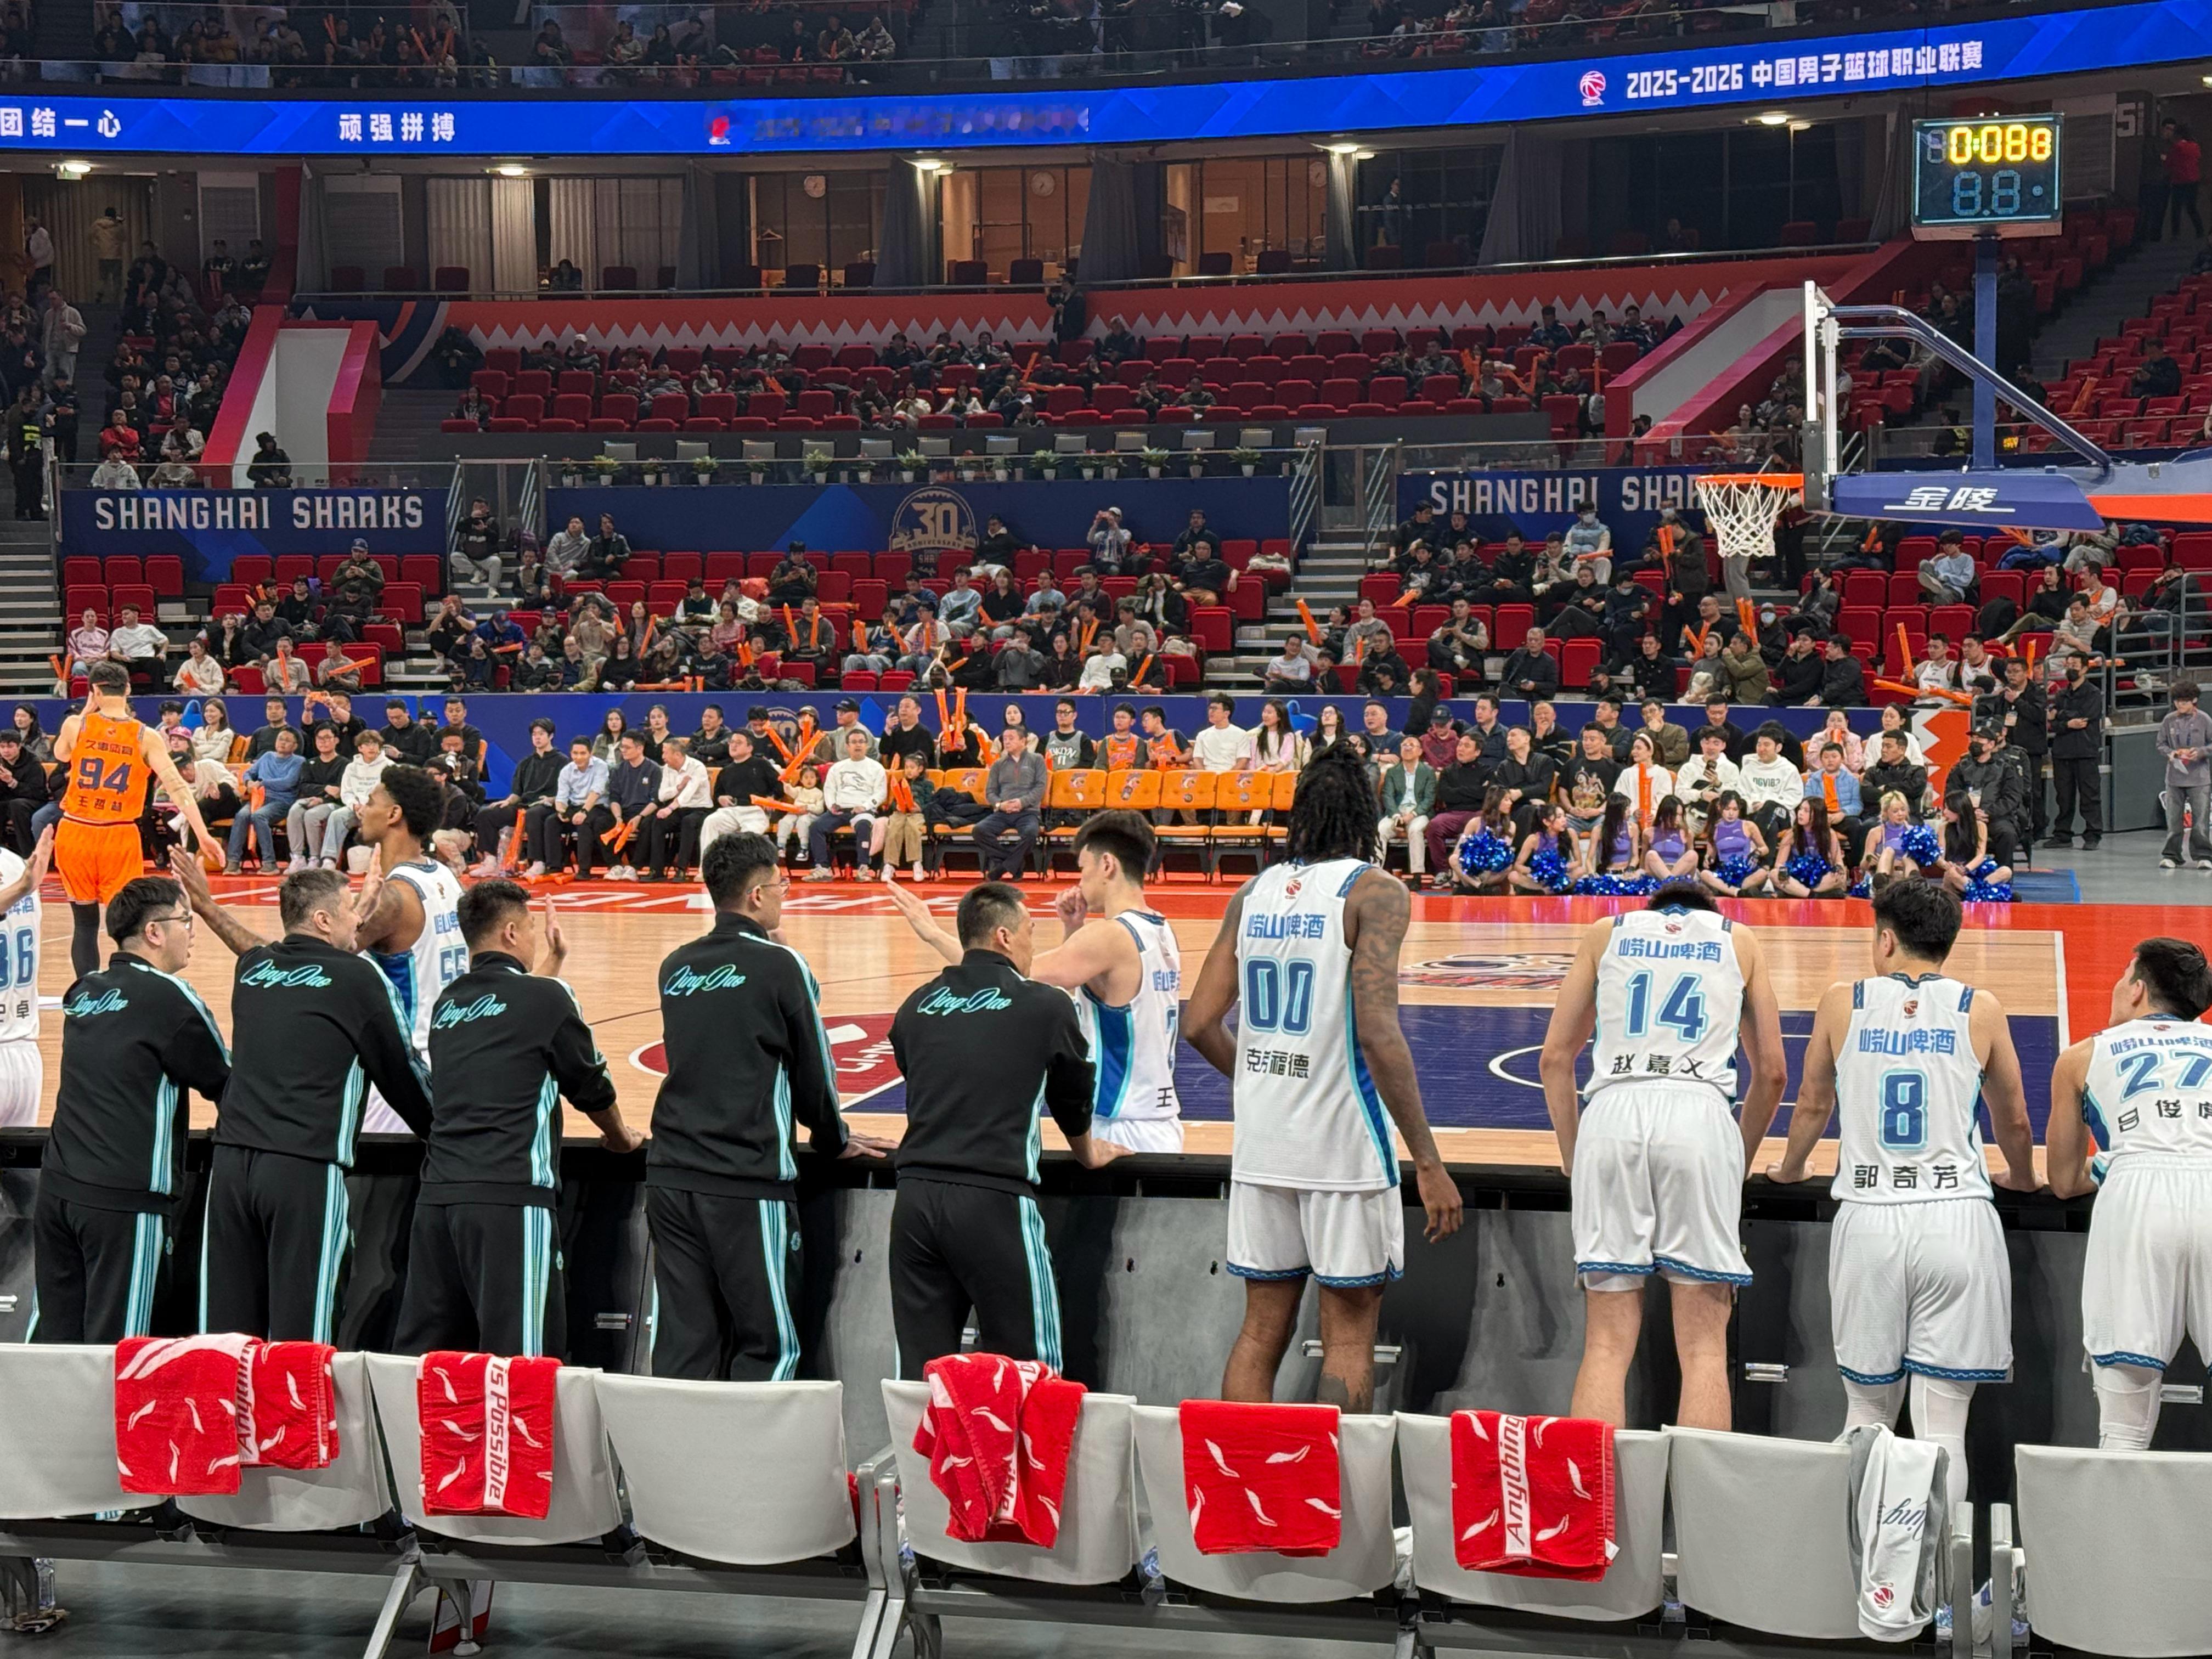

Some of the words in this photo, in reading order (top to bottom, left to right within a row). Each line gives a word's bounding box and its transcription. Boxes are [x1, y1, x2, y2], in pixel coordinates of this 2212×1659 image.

[1626, 63, 1744, 99] 2025-2026
[1751, 41, 1984, 87] 中国男子篮球职业联赛
[0, 107, 122, 138] 团结一心
[338, 112, 456, 142] 顽强拼搏
[95, 496, 269, 531] SHANGHAI
[292, 495, 424, 529] SHARKS
[1430, 476, 1599, 515] SHANGHAI
[1899, 487, 2005, 512] 金陵
[911, 501, 958, 539] 30
[77, 757, 133, 794] 94
[1245, 913, 1327, 941] 崂山啤酒
[1618, 937, 1722, 963] 崂山啤酒
[240, 958, 333, 989] QingDao
[663, 963, 746, 997] QingDao
[431, 992, 507, 1030] QingDao
[917, 986, 1013, 1016] QingDao
[1244, 955, 1316, 1036] 00
[1626, 969, 1709, 1043] 14
[1858, 1028, 1956, 1057] 崂山啤酒
[1610, 1053, 1705, 1080] 赵嘉义
[2116, 1049, 2212, 1103] 27
[1878, 1068, 1928, 1150] 8
[1853, 1164, 1958, 1189] 郭奇芳
[490, 1362, 510, 1387] is
[486, 1389, 509, 1501] Possible
[1499, 1415, 1528, 1548] Anything
